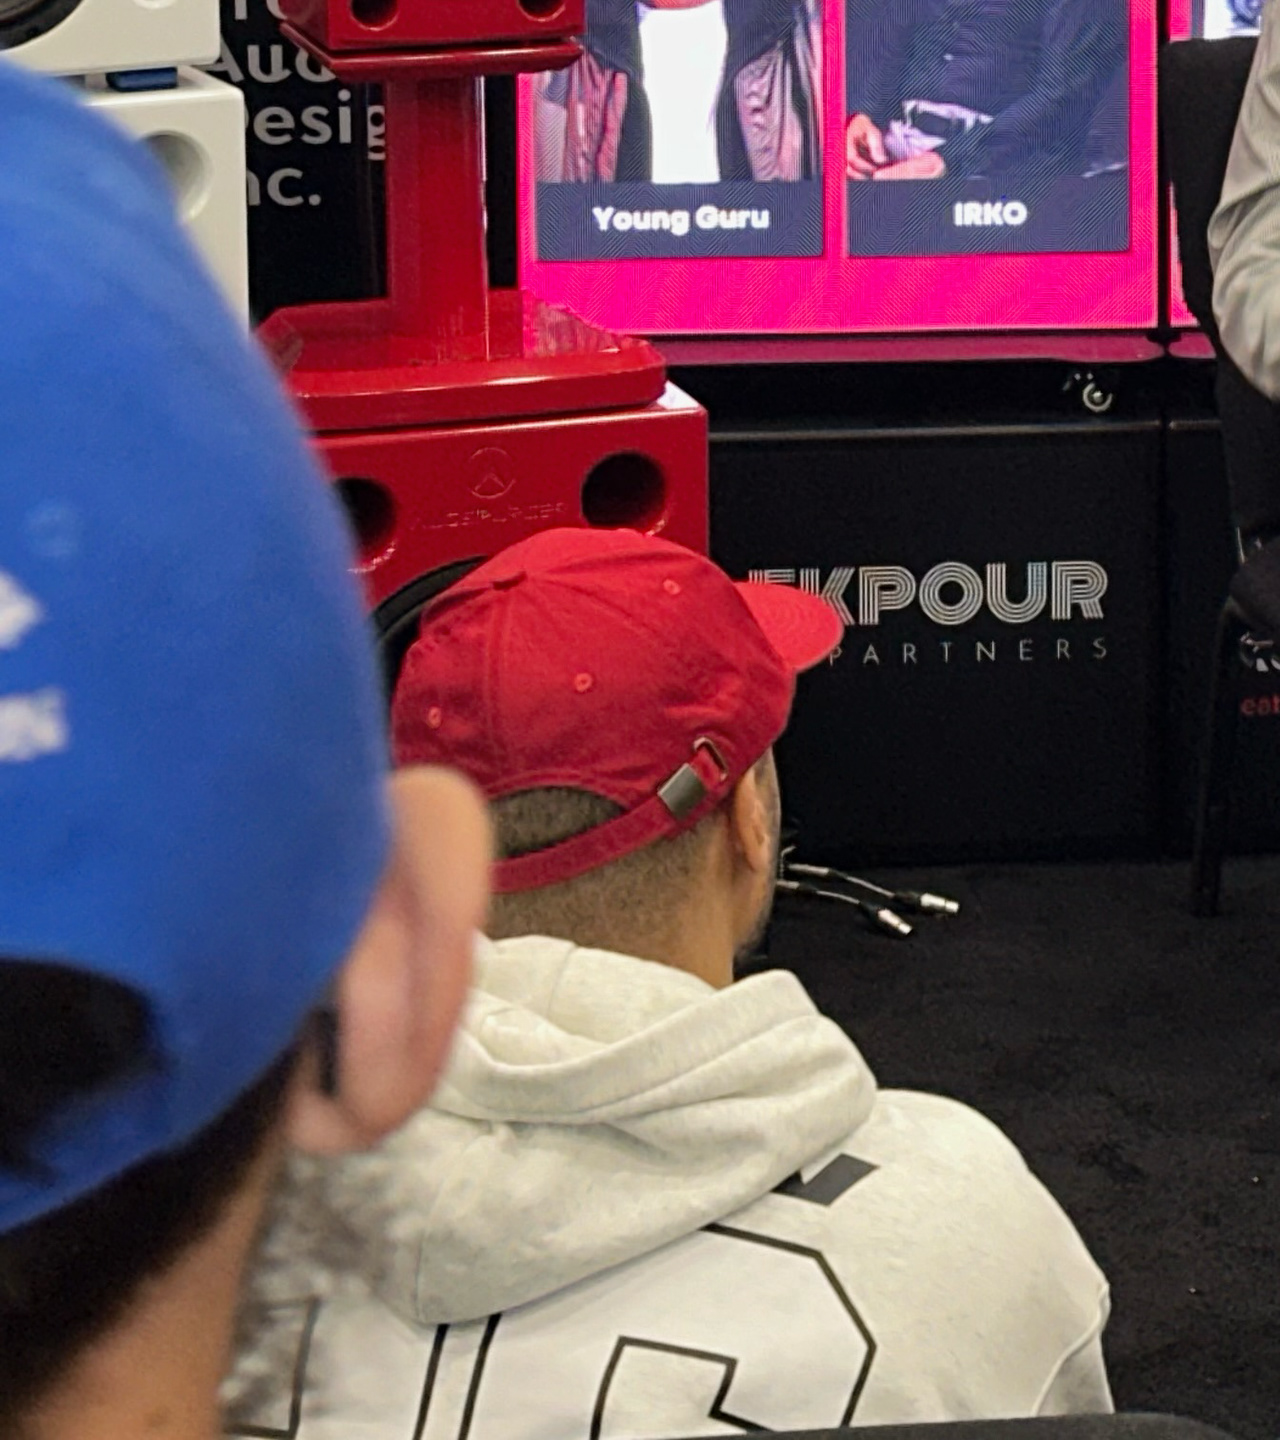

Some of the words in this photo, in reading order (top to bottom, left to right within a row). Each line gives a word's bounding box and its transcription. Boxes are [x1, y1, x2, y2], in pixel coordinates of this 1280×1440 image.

[592, 206, 691, 237] Young
[694, 204, 770, 230] Guru
[953, 200, 1028, 227] IRKO
[827, 636, 1108, 666] PARTNERS
